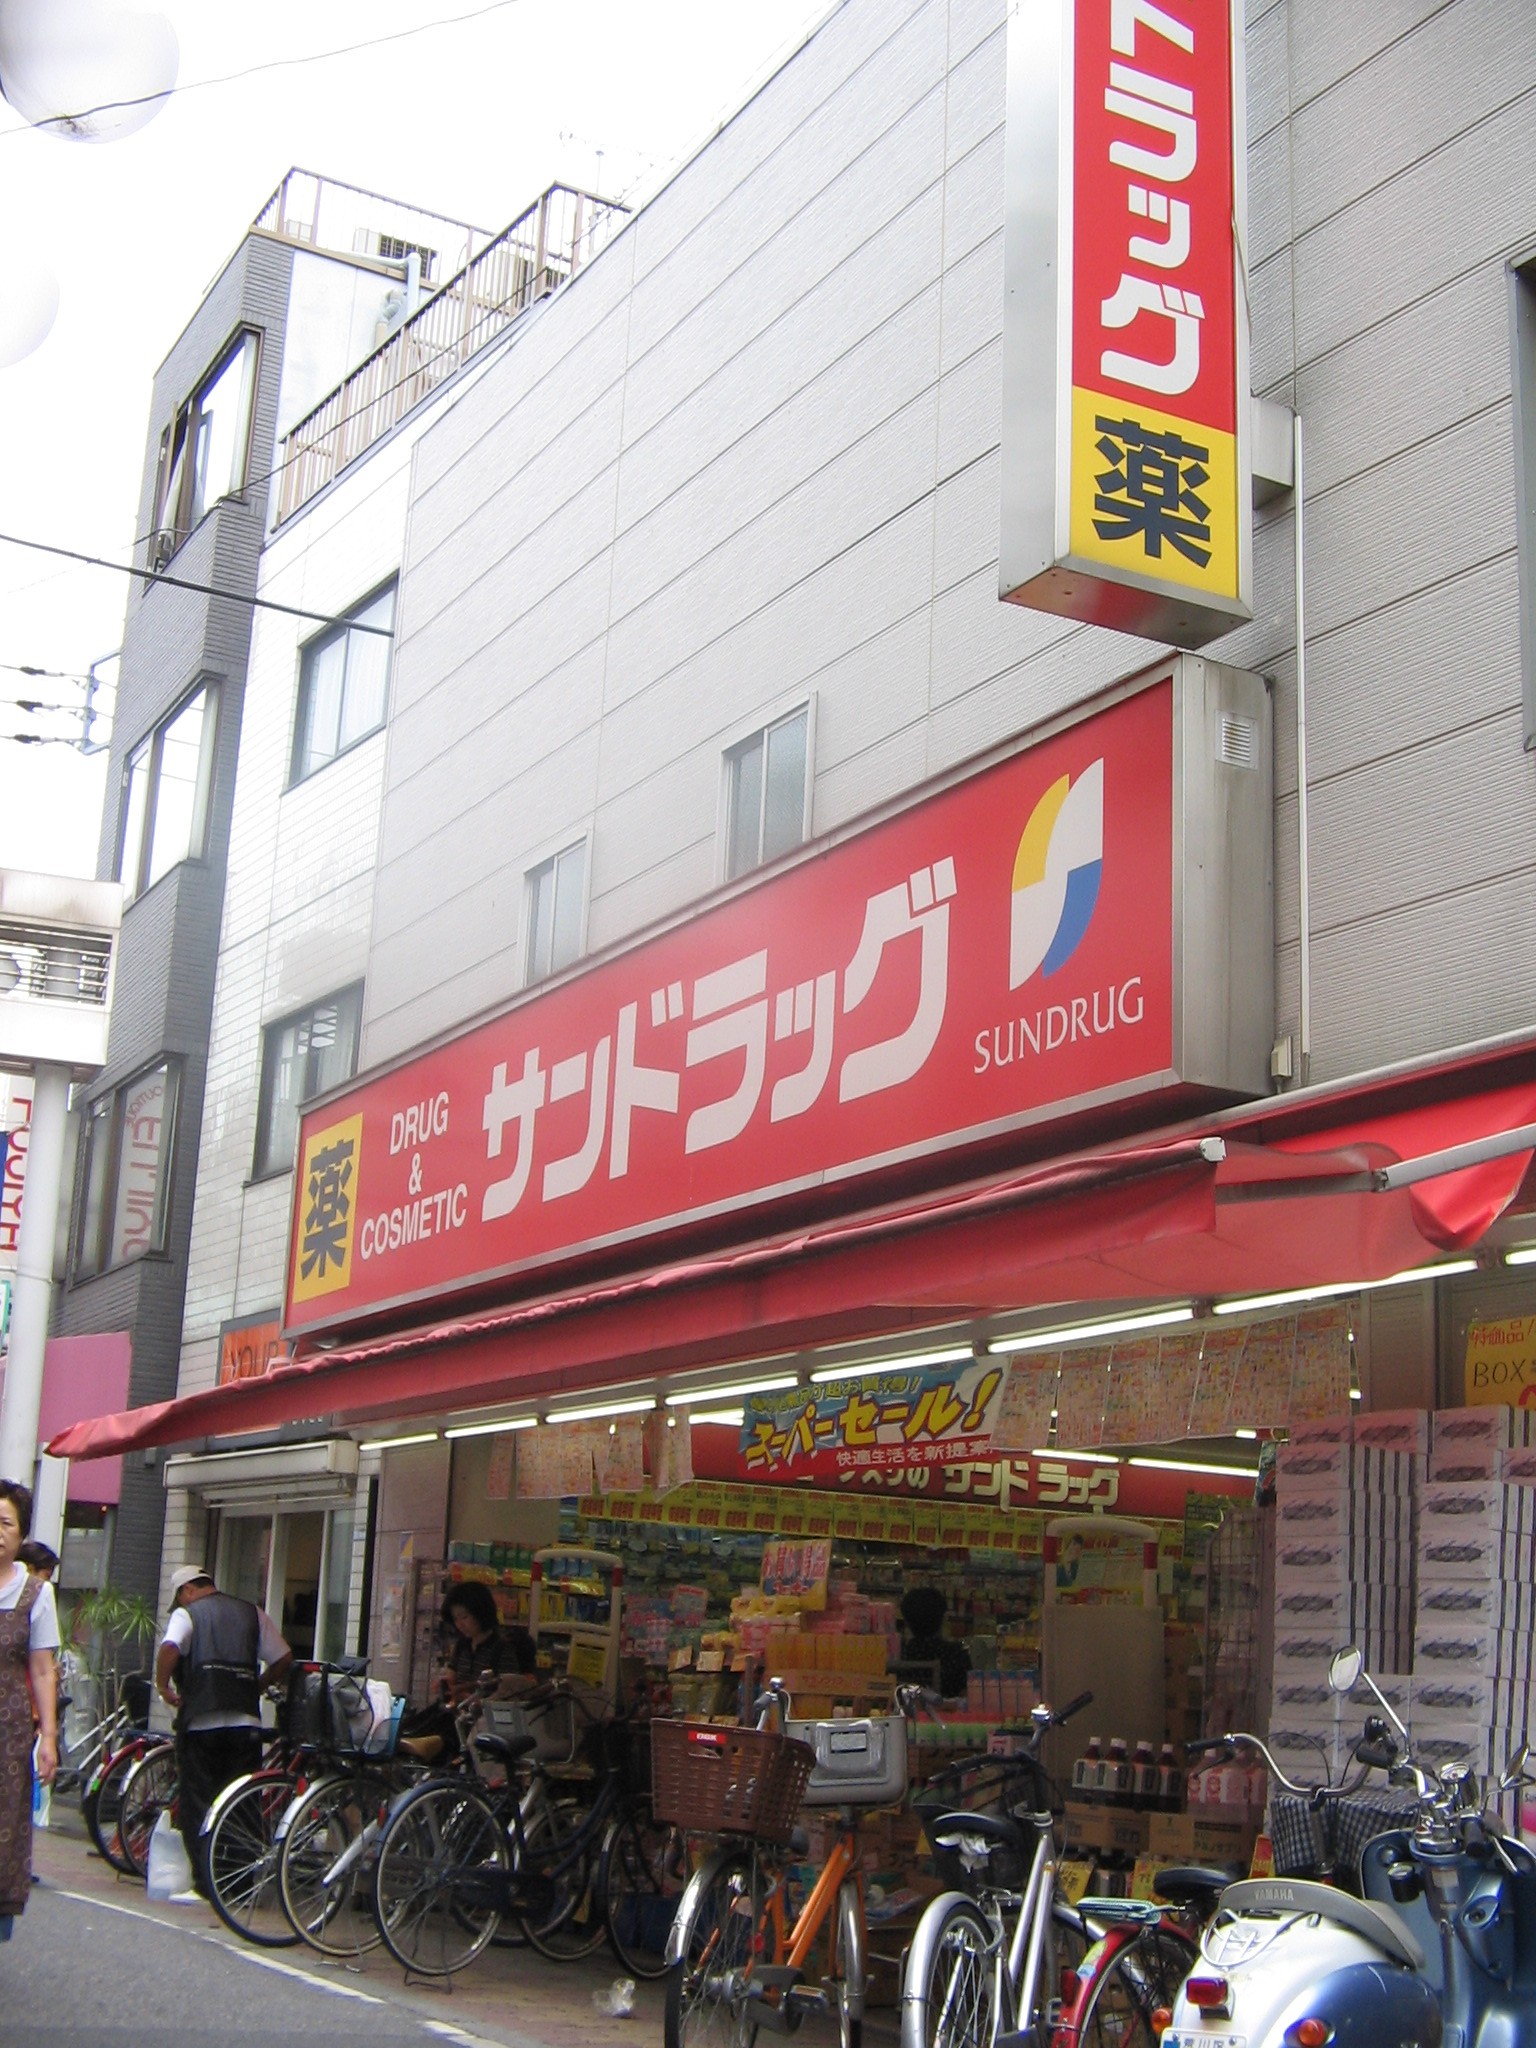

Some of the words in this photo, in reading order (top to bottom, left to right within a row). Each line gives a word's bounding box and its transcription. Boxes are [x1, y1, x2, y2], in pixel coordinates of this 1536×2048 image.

[1092, 414, 1212, 569] 薬
[481, 856, 957, 1222] サンドラッグ
[974, 976, 1144, 1074] SUNDRUG
[390, 1091, 449, 1155] DRUG
[301, 1139, 355, 1281] 薬
[408, 1152, 423, 1196] &
[360, 1183, 468, 1260] COSMETIC
[1474, 1359, 1526, 1388] BOX
[1254, 1888, 1295, 1901] YAMAHA
